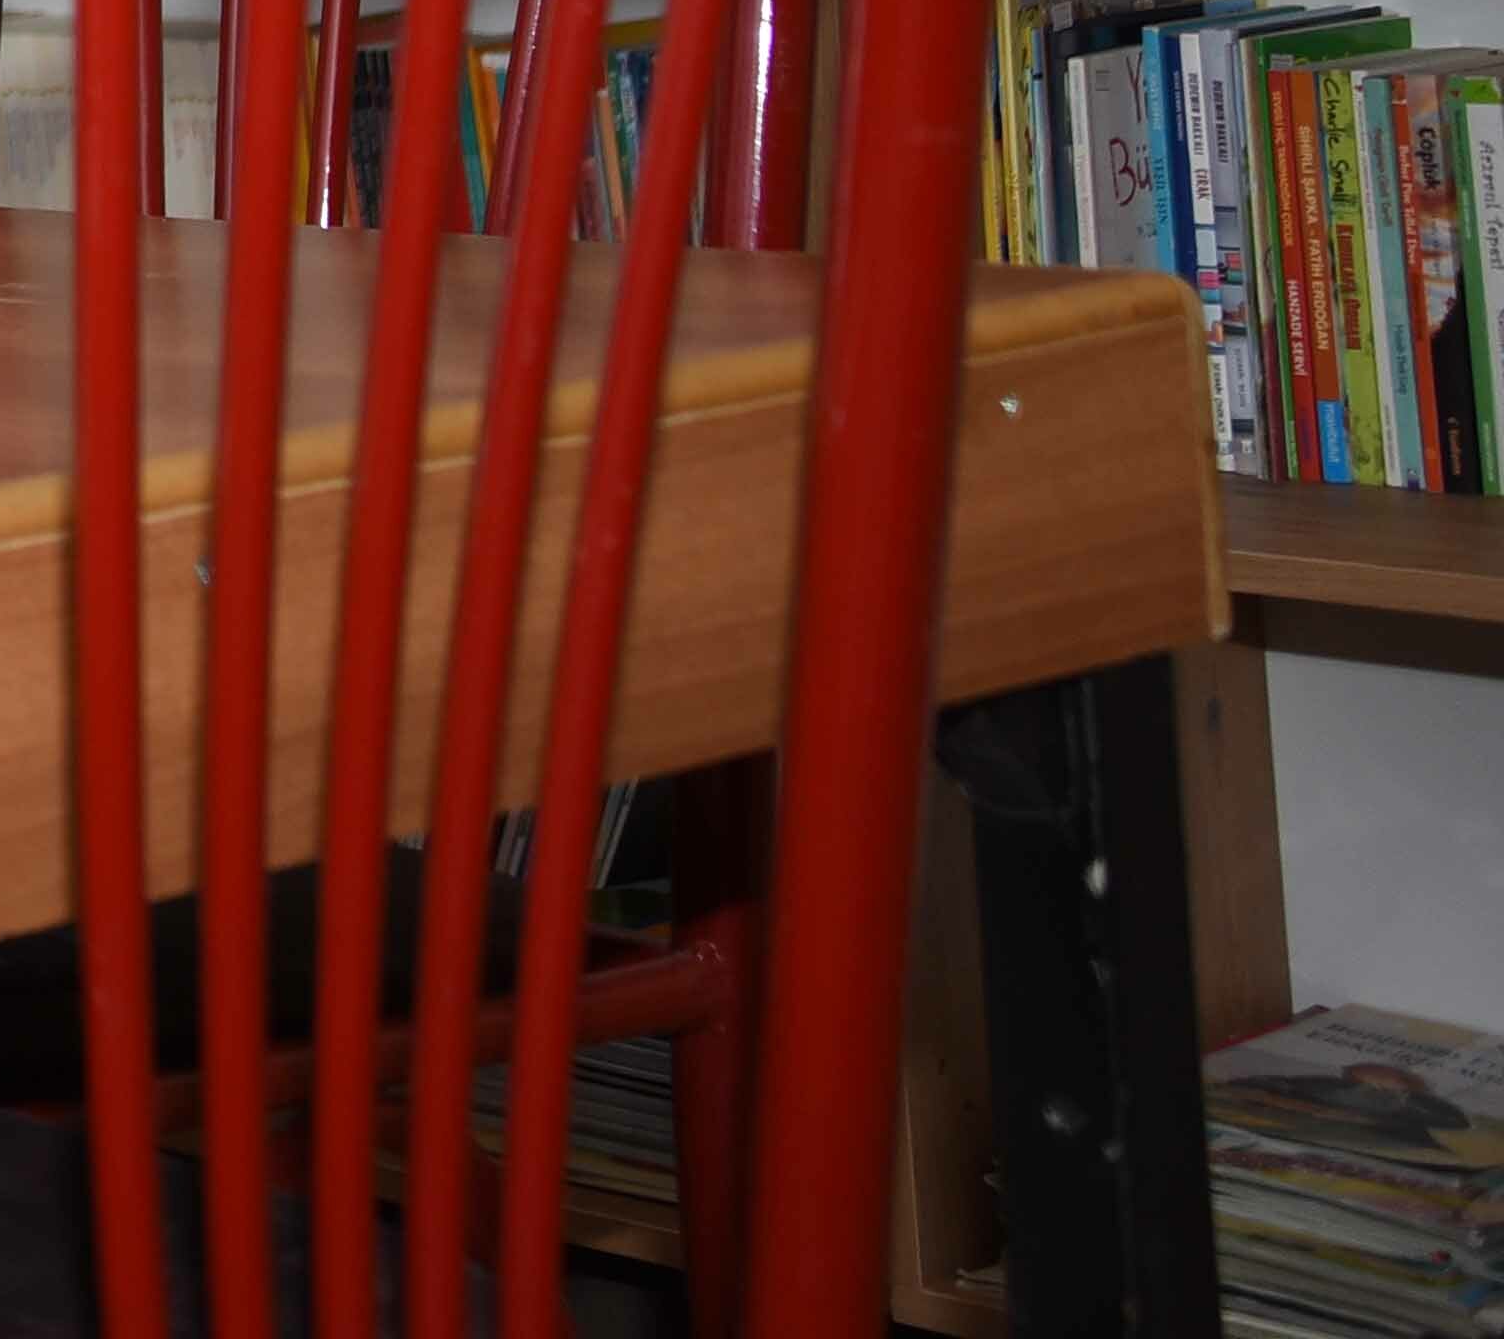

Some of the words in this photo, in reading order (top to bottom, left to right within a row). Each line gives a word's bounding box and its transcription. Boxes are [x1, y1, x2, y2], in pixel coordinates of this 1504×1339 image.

[1322, 78, 1350, 148] Charlie
[1192, 168, 1210, 200] ÇIRAK
[1299, 177, 1318, 224] ŞAPKA
[1330, 158, 1353, 205] Small
[1308, 238, 1326, 277] FATİH
[1286, 278, 1303, 336] HANZADE
[1311, 280, 1329, 350] ERDOĞAN
[1290, 340, 1307, 376] SERVİ
